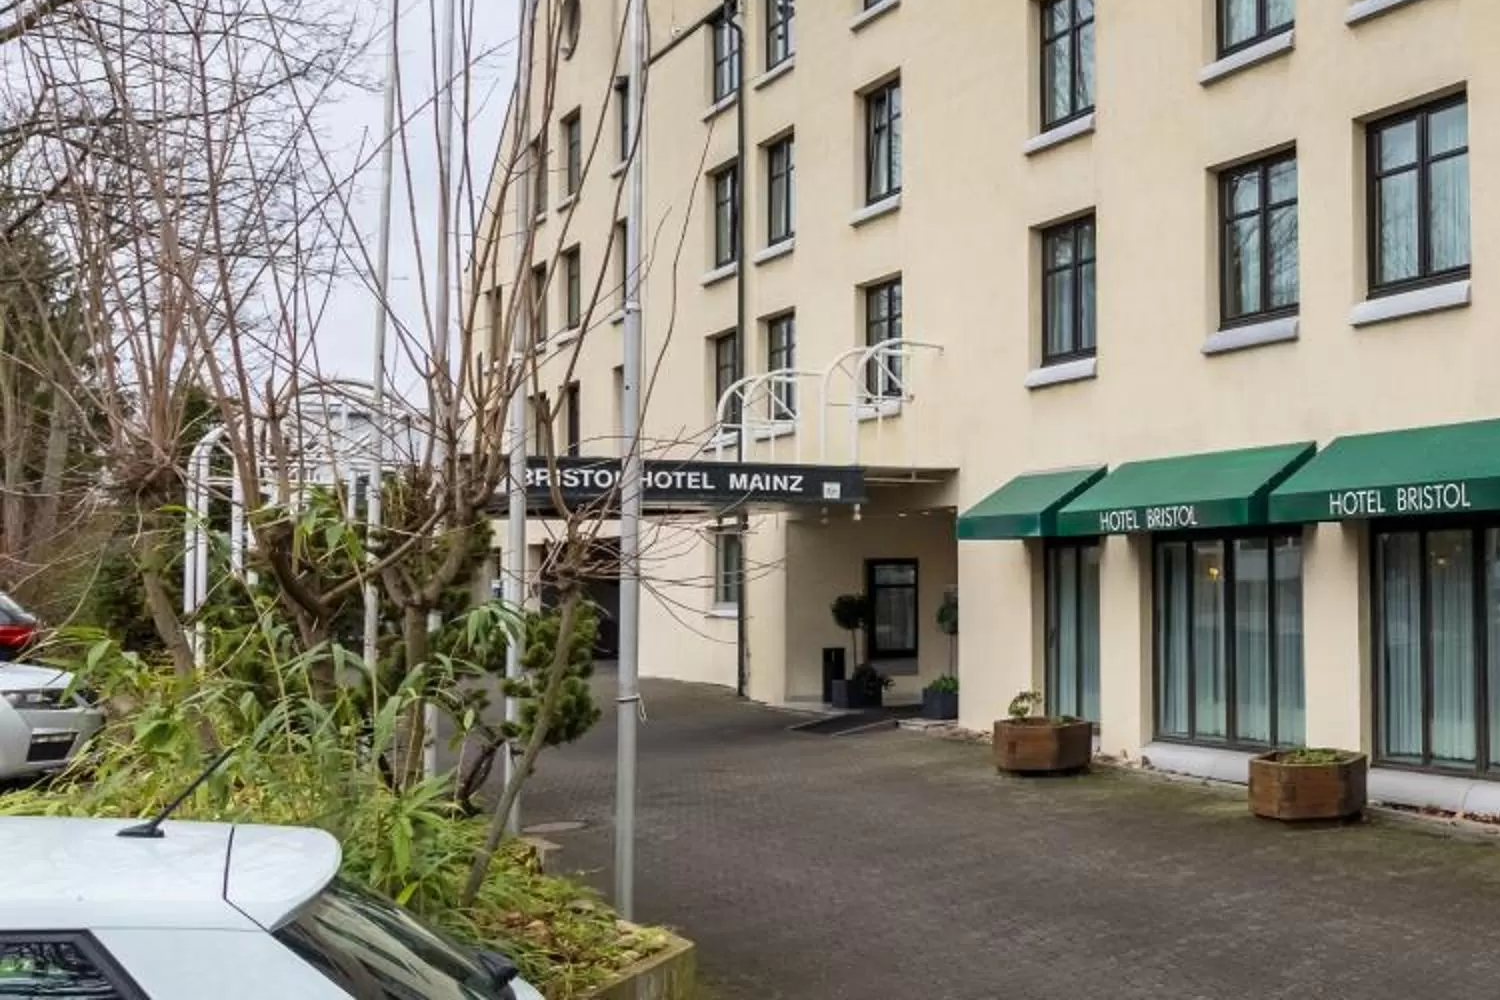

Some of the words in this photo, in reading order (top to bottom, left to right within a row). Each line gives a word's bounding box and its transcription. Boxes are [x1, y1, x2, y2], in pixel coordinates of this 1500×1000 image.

[639, 470, 716, 490] HOTEL
[729, 472, 804, 493] MAINZ
[1329, 488, 1386, 516] HOTEL
[1397, 481, 1471, 512] BRISTOL
[1099, 509, 1140, 532] HOTEL
[1145, 505, 1198, 530] BRISTOL
